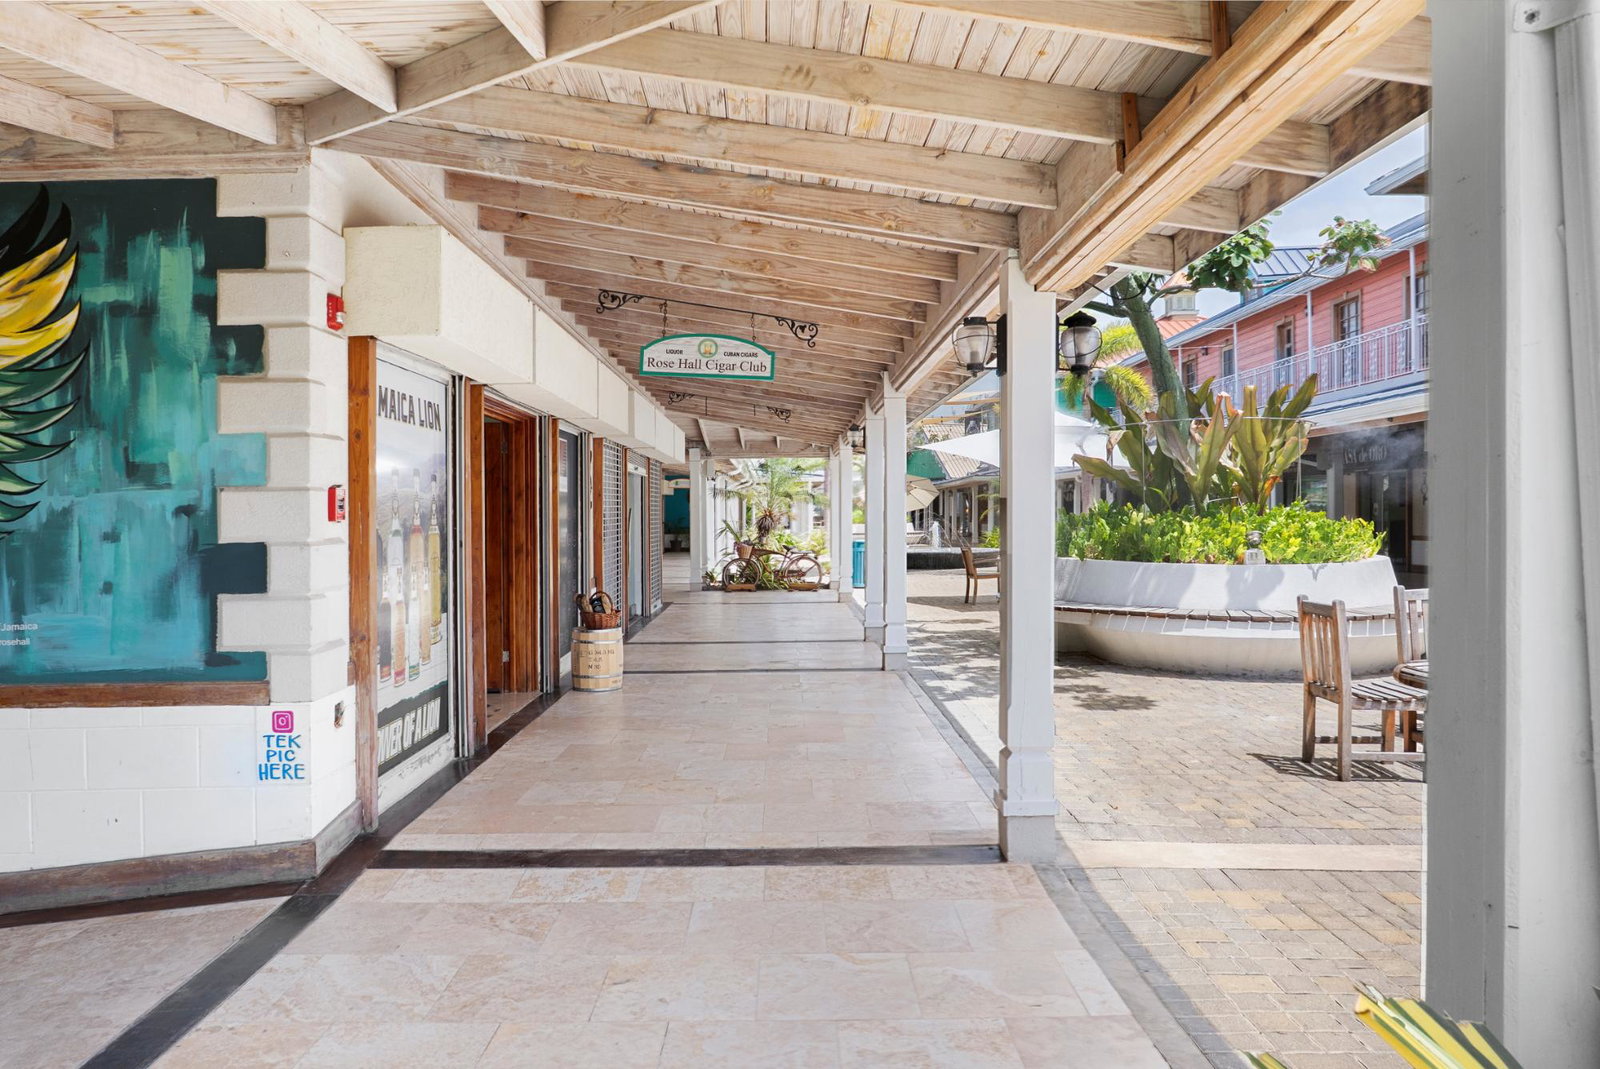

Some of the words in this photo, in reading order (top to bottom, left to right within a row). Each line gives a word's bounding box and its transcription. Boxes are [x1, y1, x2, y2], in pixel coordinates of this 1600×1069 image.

[647, 357, 675, 368] Rose
[678, 358, 702, 370] Hall
[705, 360, 737, 373] Cigar
[739, 361, 767, 373] Club
[378, 385, 416, 425] MAICA
[418, 397, 442, 432] LION
[1, 623, 38, 631] Jamaica
[403, 709, 416, 750] OF
[414, 706, 422, 744] A
[263, 734, 301, 748] TEK
[266, 749, 296, 762] PIC
[258, 763, 305, 781] HERE
